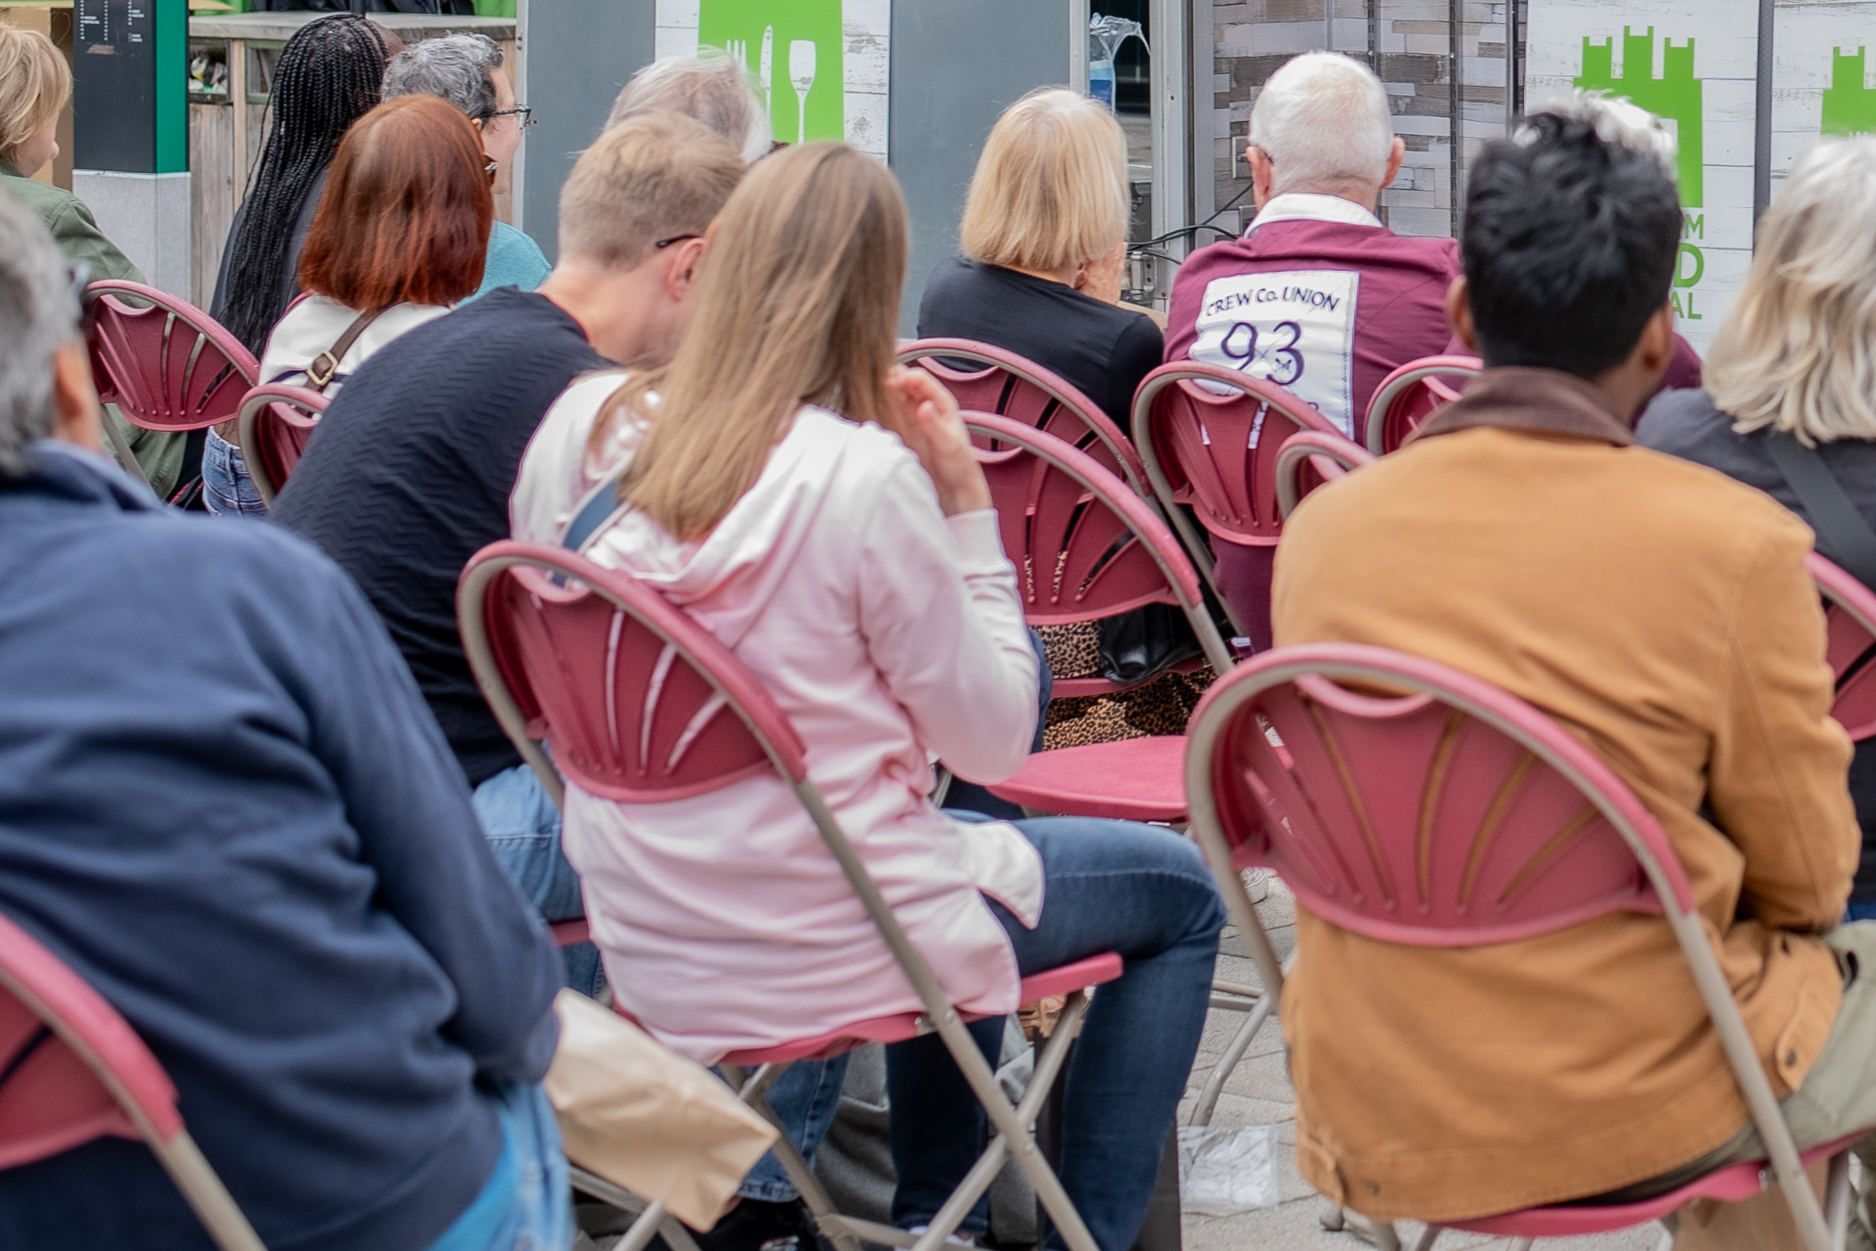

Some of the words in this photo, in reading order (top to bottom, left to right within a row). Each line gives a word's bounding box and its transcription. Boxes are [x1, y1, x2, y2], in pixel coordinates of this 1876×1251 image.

[1206, 289, 1254, 317] CREW
[1282, 287, 1341, 311] UNION
[1220, 321, 1305, 386] 93
